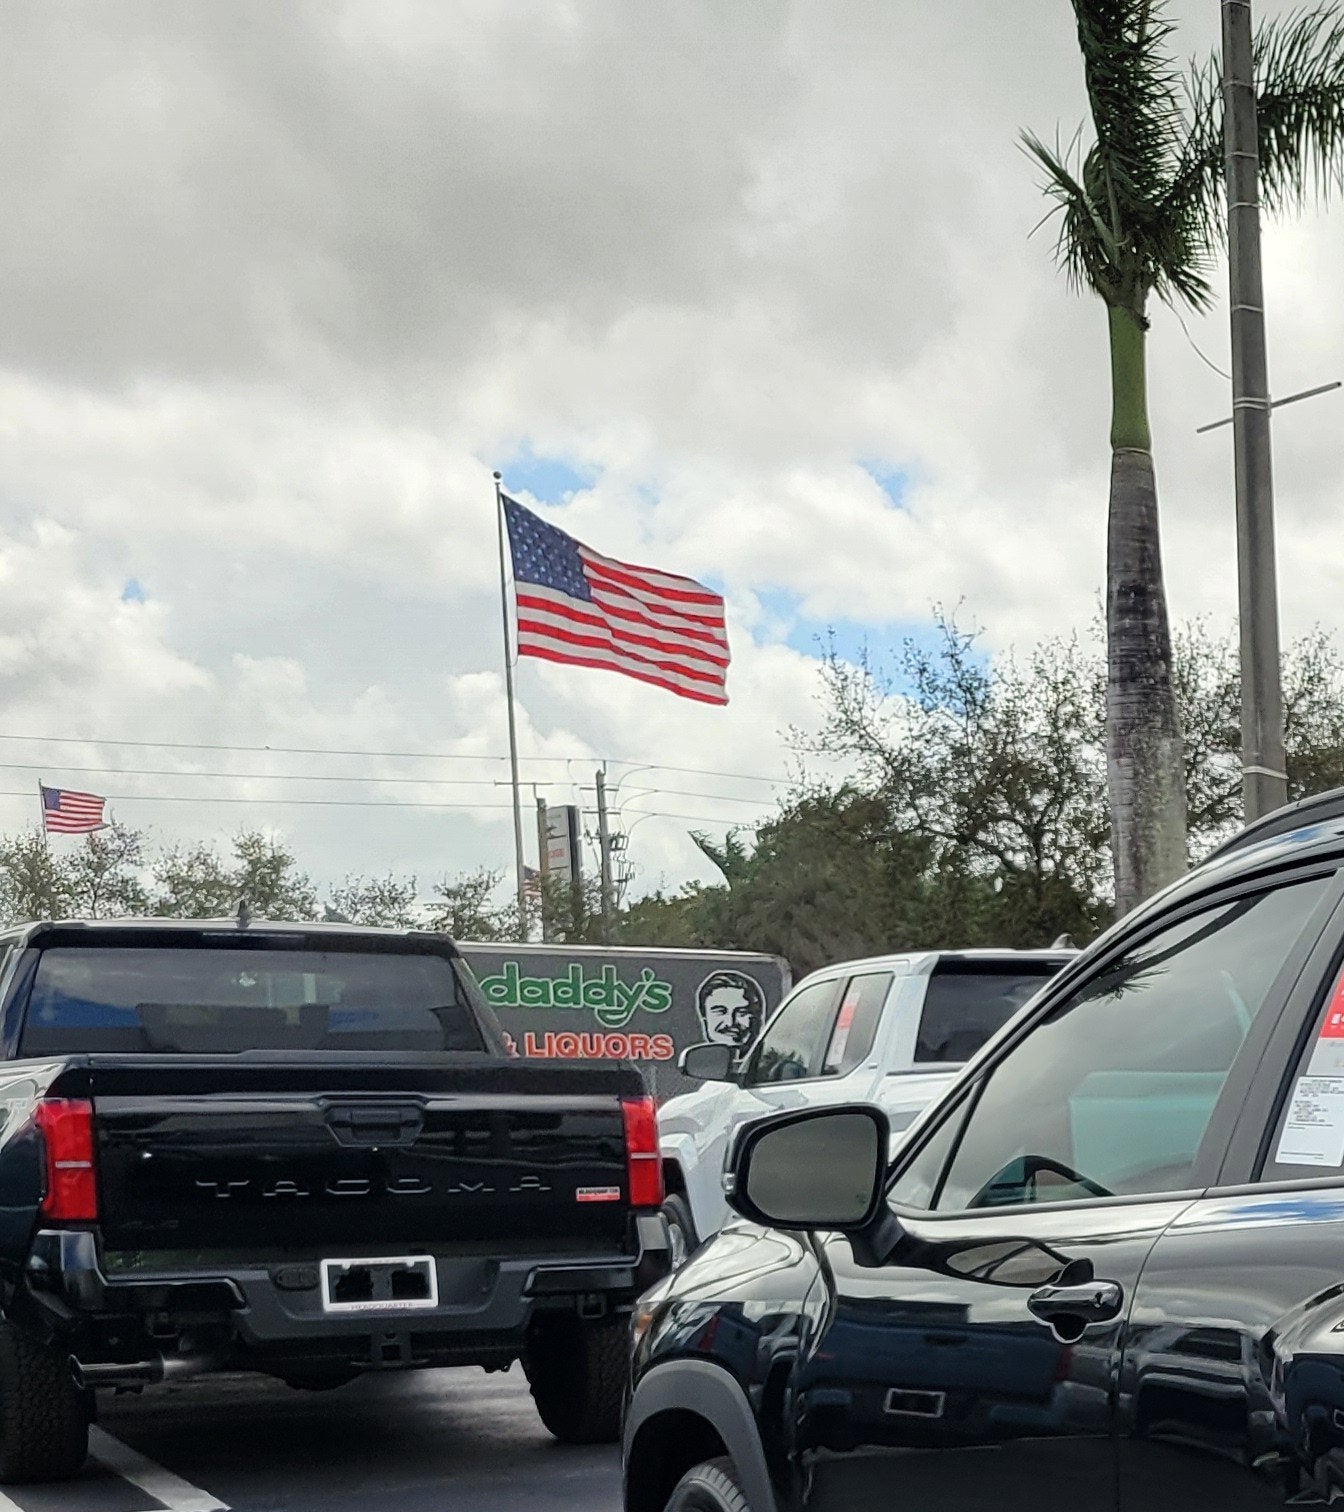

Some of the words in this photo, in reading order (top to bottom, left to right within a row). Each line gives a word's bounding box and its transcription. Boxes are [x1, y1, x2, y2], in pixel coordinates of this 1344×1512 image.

[479, 961, 673, 1029] daddy's
[524, 1031, 675, 1061] LIQUORS
[196, 1176, 552, 1198] TACOMA
